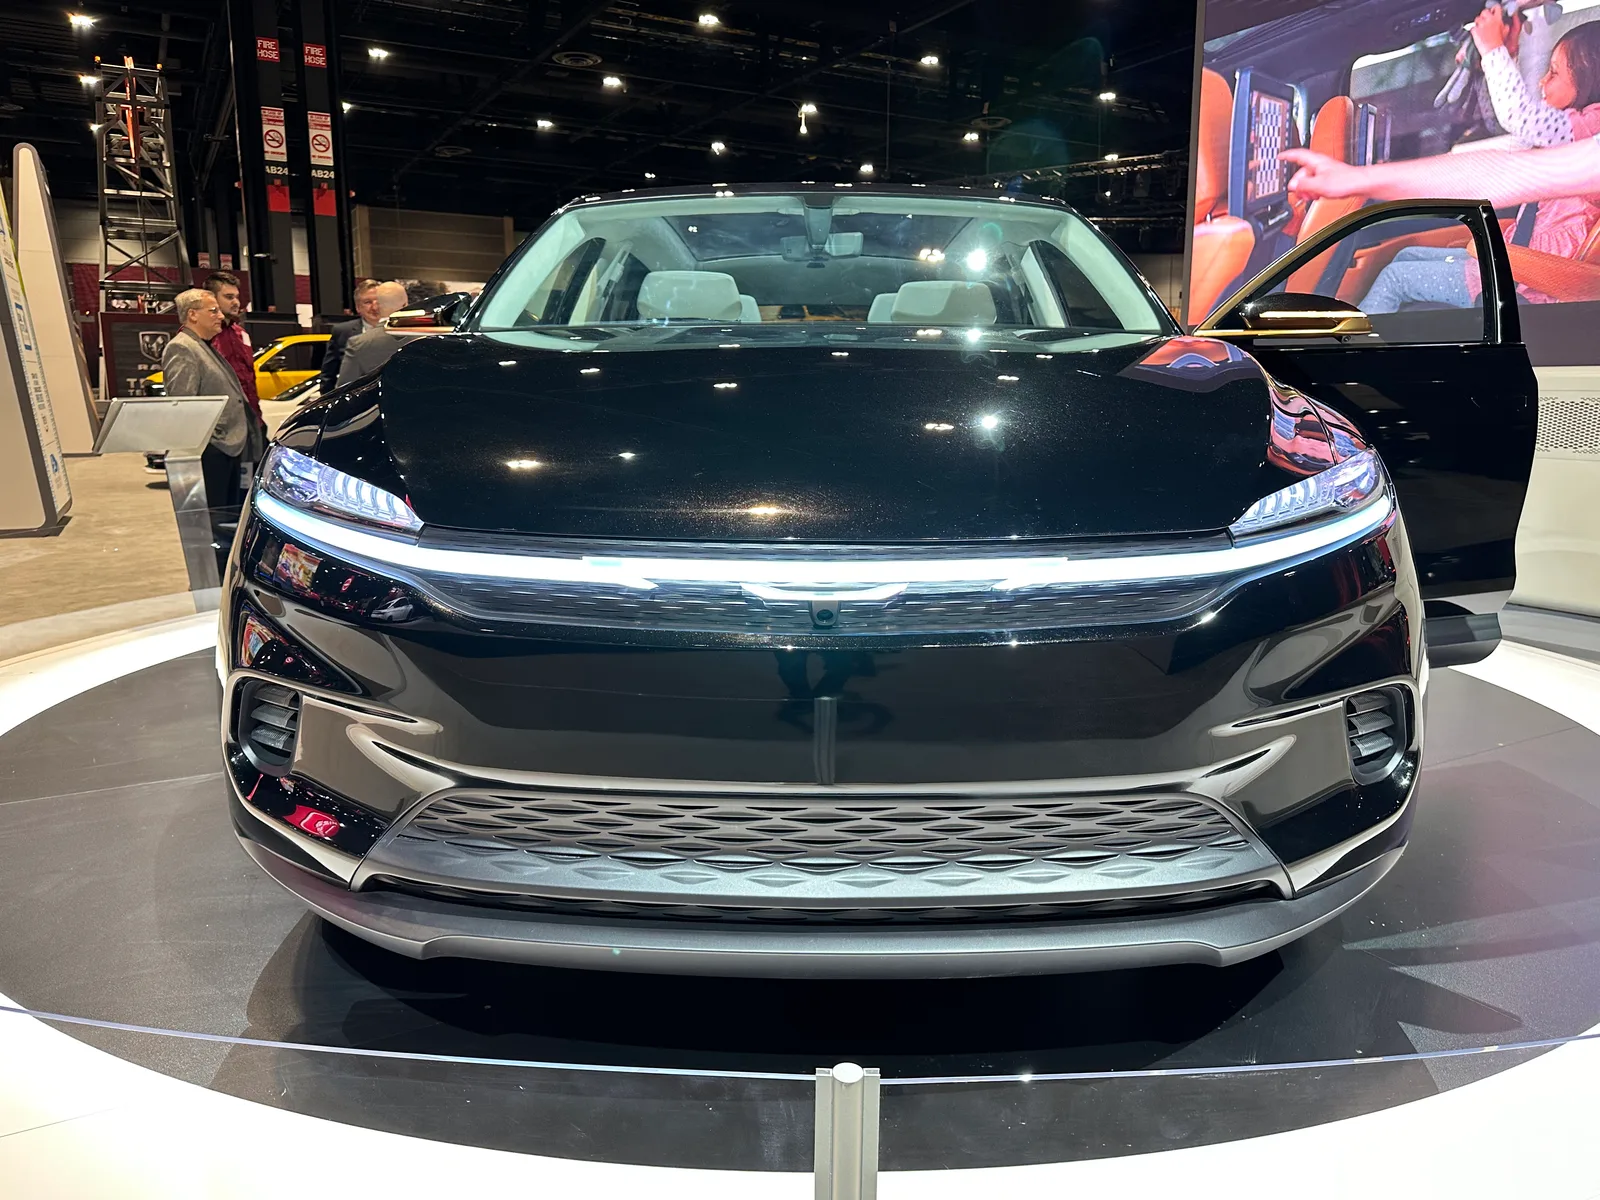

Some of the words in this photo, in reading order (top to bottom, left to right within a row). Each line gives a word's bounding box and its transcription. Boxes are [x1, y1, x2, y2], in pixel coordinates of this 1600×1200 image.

[257, 39, 277, 50] FIRE
[257, 48, 279, 60] HOSE
[305, 46, 324, 56] FIRE
[304, 55, 327, 66] HOSE
[265, 165, 289, 176] AB24
[311, 169, 335, 179] AB24
